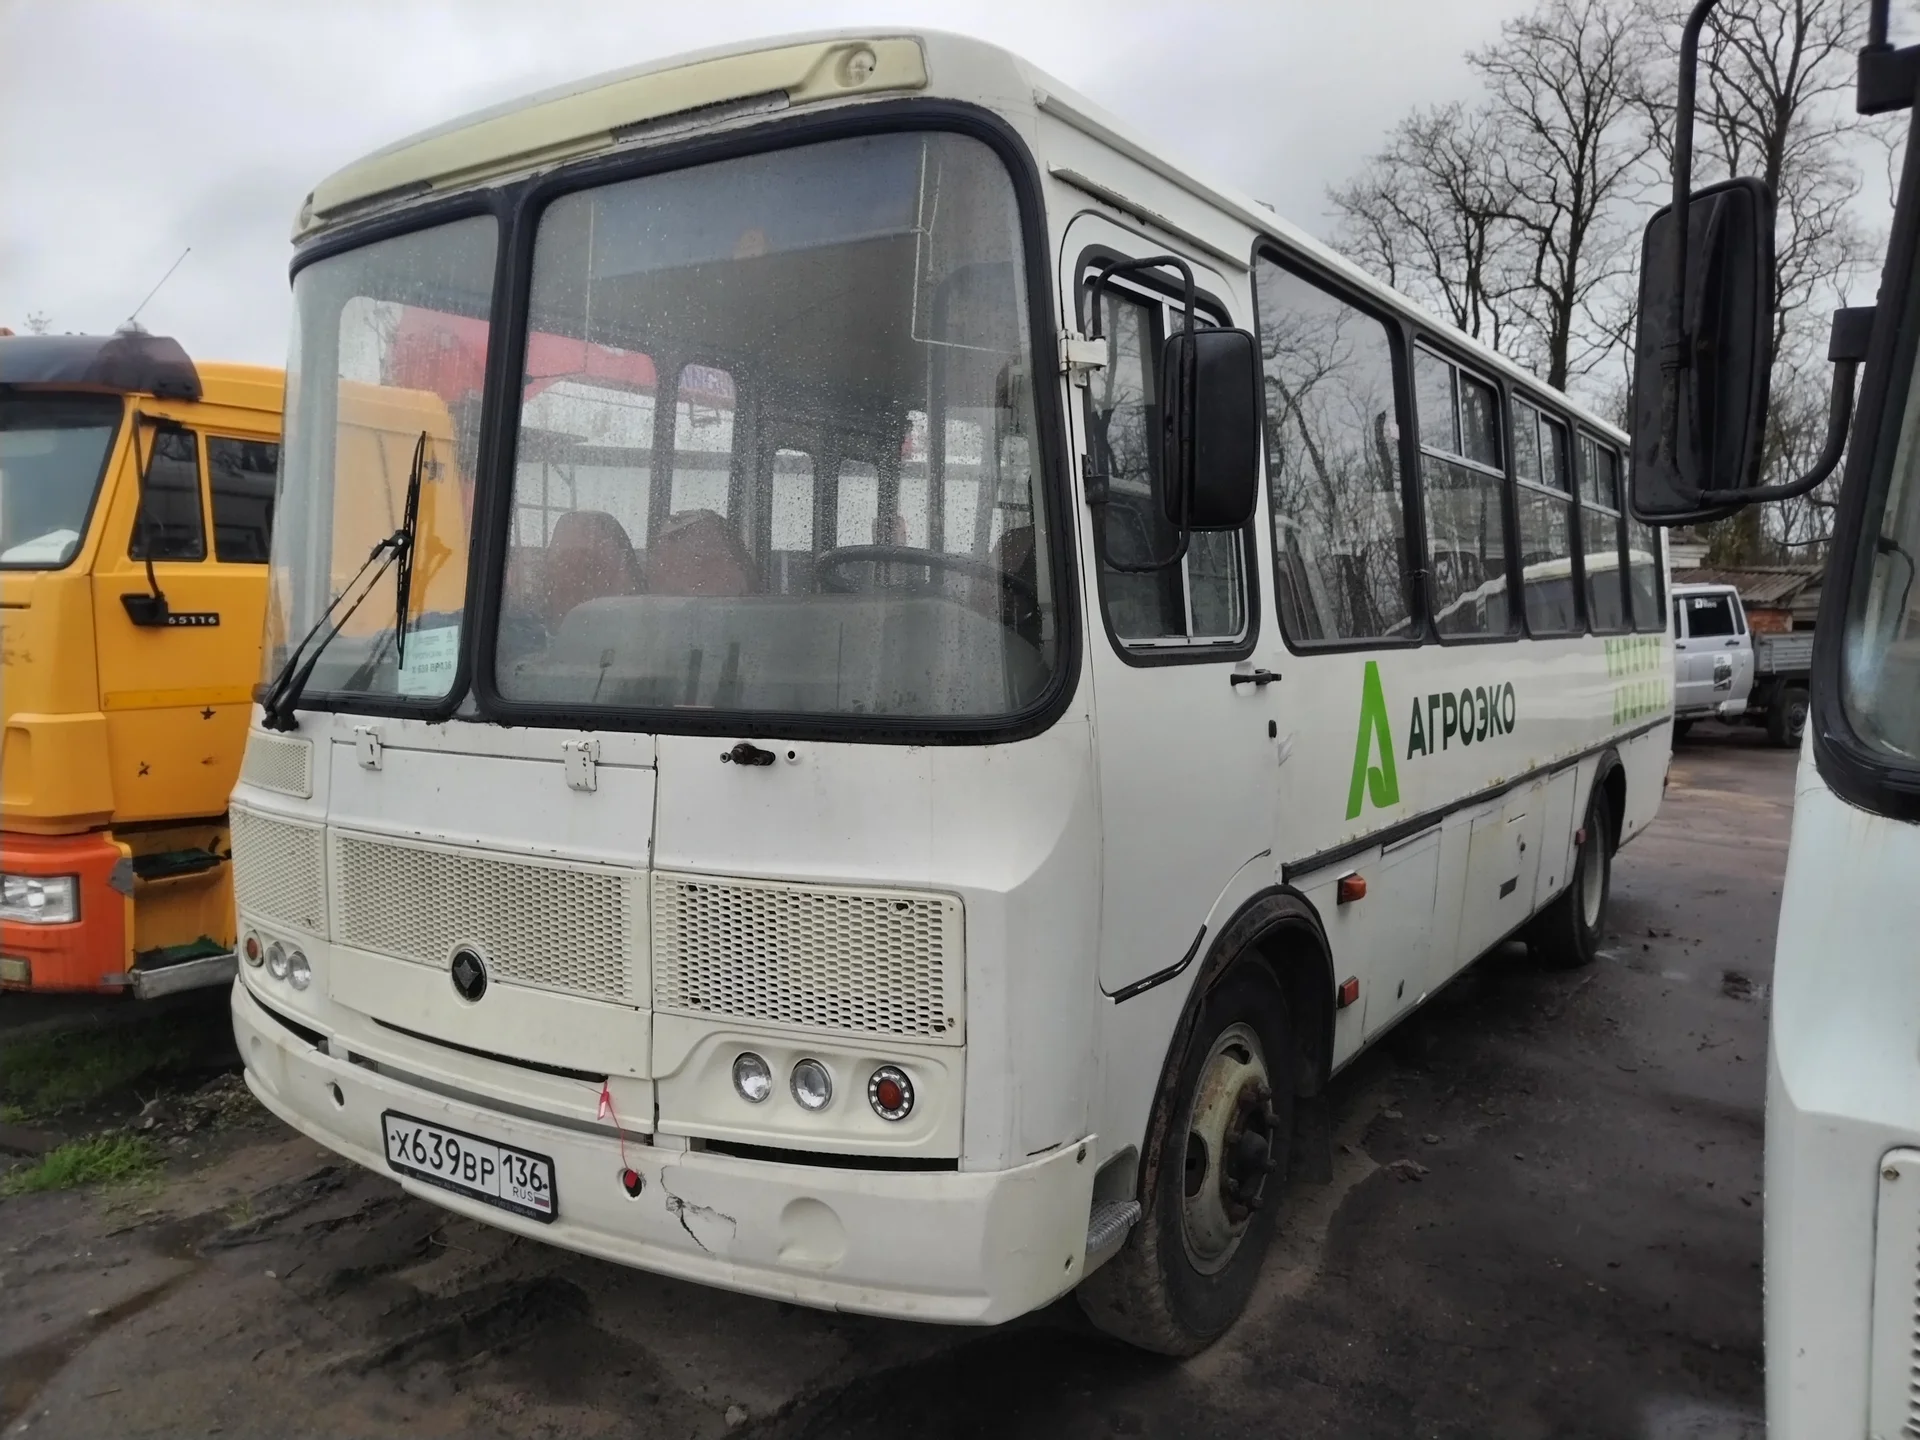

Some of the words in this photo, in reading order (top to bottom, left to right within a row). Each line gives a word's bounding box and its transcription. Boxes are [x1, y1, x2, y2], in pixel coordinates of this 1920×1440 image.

[168, 616, 217, 625] 65116
[1406, 681, 1516, 760] АГРОЭКО
[502, 1154, 543, 1192] 136
[512, 1186, 534, 1202] RUS
